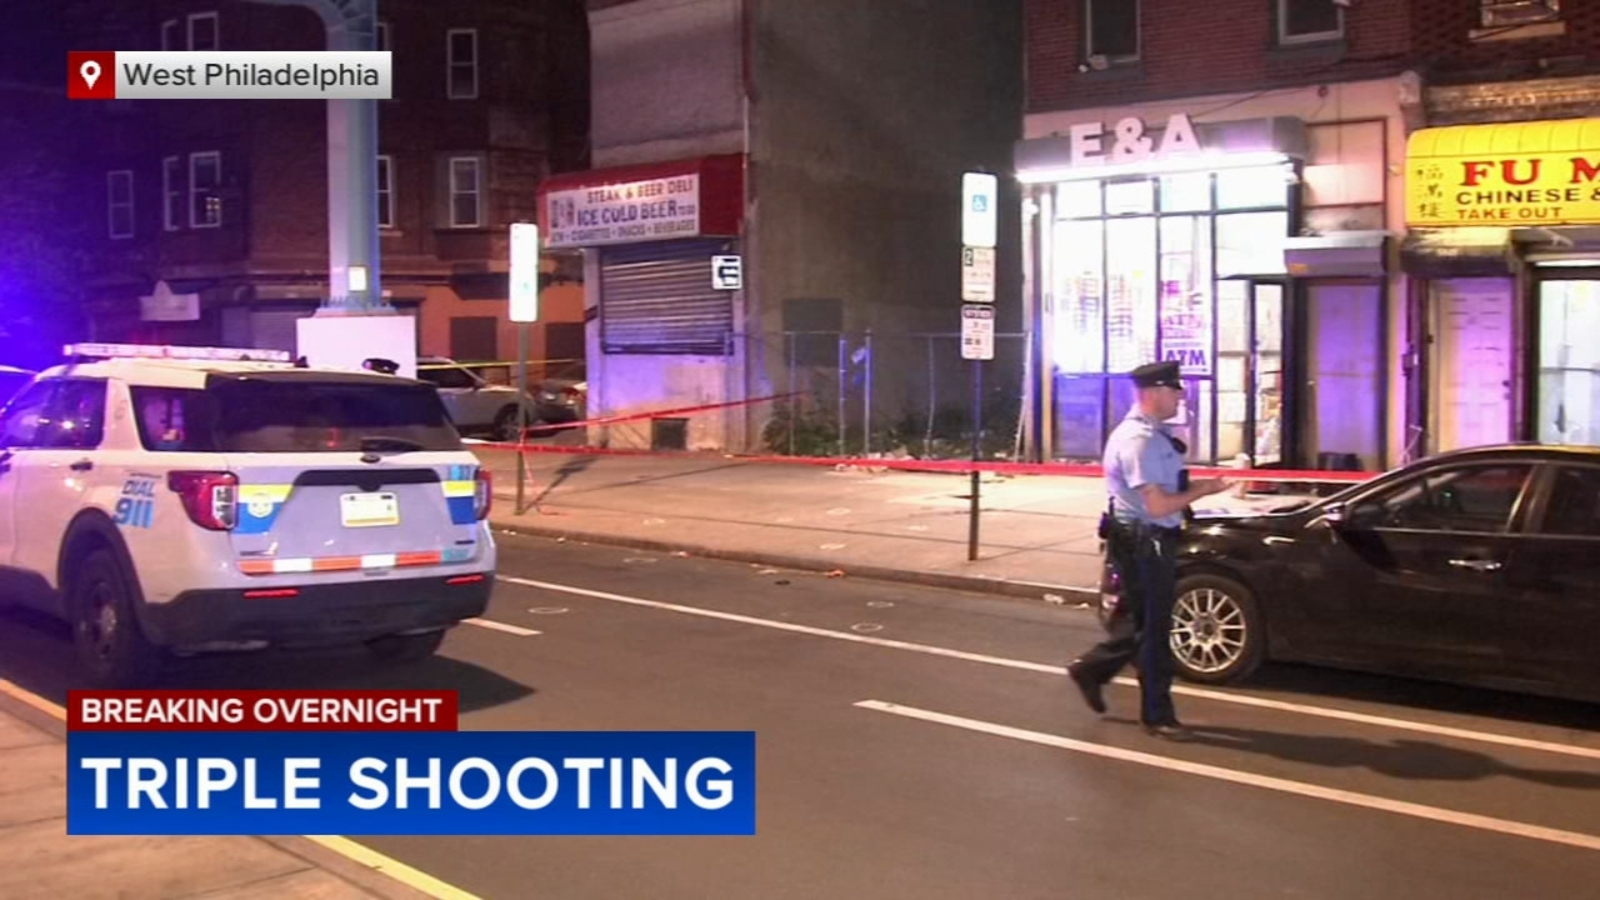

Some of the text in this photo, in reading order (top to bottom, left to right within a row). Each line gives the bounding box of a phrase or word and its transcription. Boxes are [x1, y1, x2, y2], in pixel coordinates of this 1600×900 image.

[1459, 159, 1542, 187] FU
[587, 190, 621, 204] STEAK
[638, 184, 664, 198] BEER
[668, 179, 694, 194] DELI
[1456, 188, 1581, 205] CHINESE
[577, 208, 600, 228] ICE
[602, 205, 637, 224] COLD
[640, 200, 677, 220] BEER
[1457, 206, 1563, 220] TAKE OUT
[1166, 350, 1206, 366] ATM
[122, 480, 155, 497] DIAL
[112, 498, 154, 529] 911
